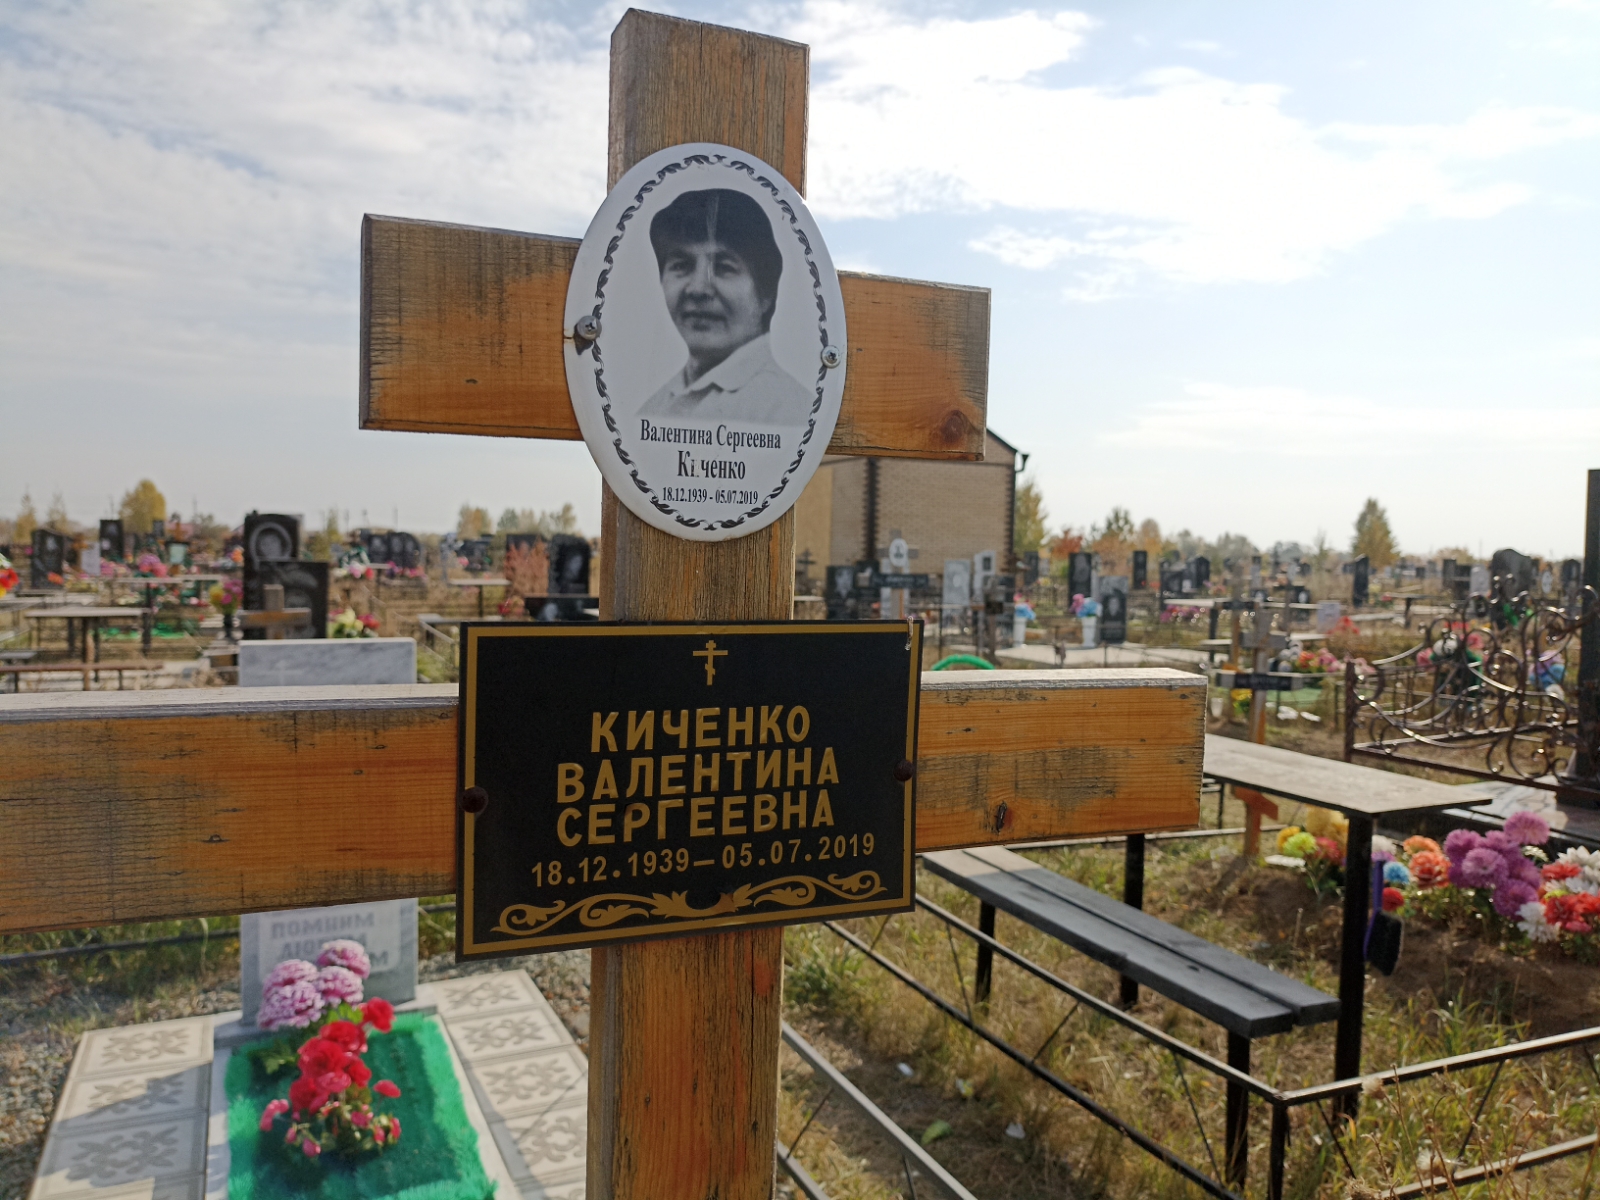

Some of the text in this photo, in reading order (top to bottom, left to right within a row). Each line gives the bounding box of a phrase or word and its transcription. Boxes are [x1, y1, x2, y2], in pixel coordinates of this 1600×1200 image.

[640, 418, 781, 452] Валентина Сергеевна
[662, 486, 708, 503] 18.12.1939
[715, 489, 759, 505] 05.07.2019
[591, 705, 811, 753] КИЧЕНКО
[556, 747, 840, 804] ВАЛЕНТИНА
[556, 789, 835, 847] СЕРГЕЕВНА
[272, 912, 375, 939] ПОМНИМ
